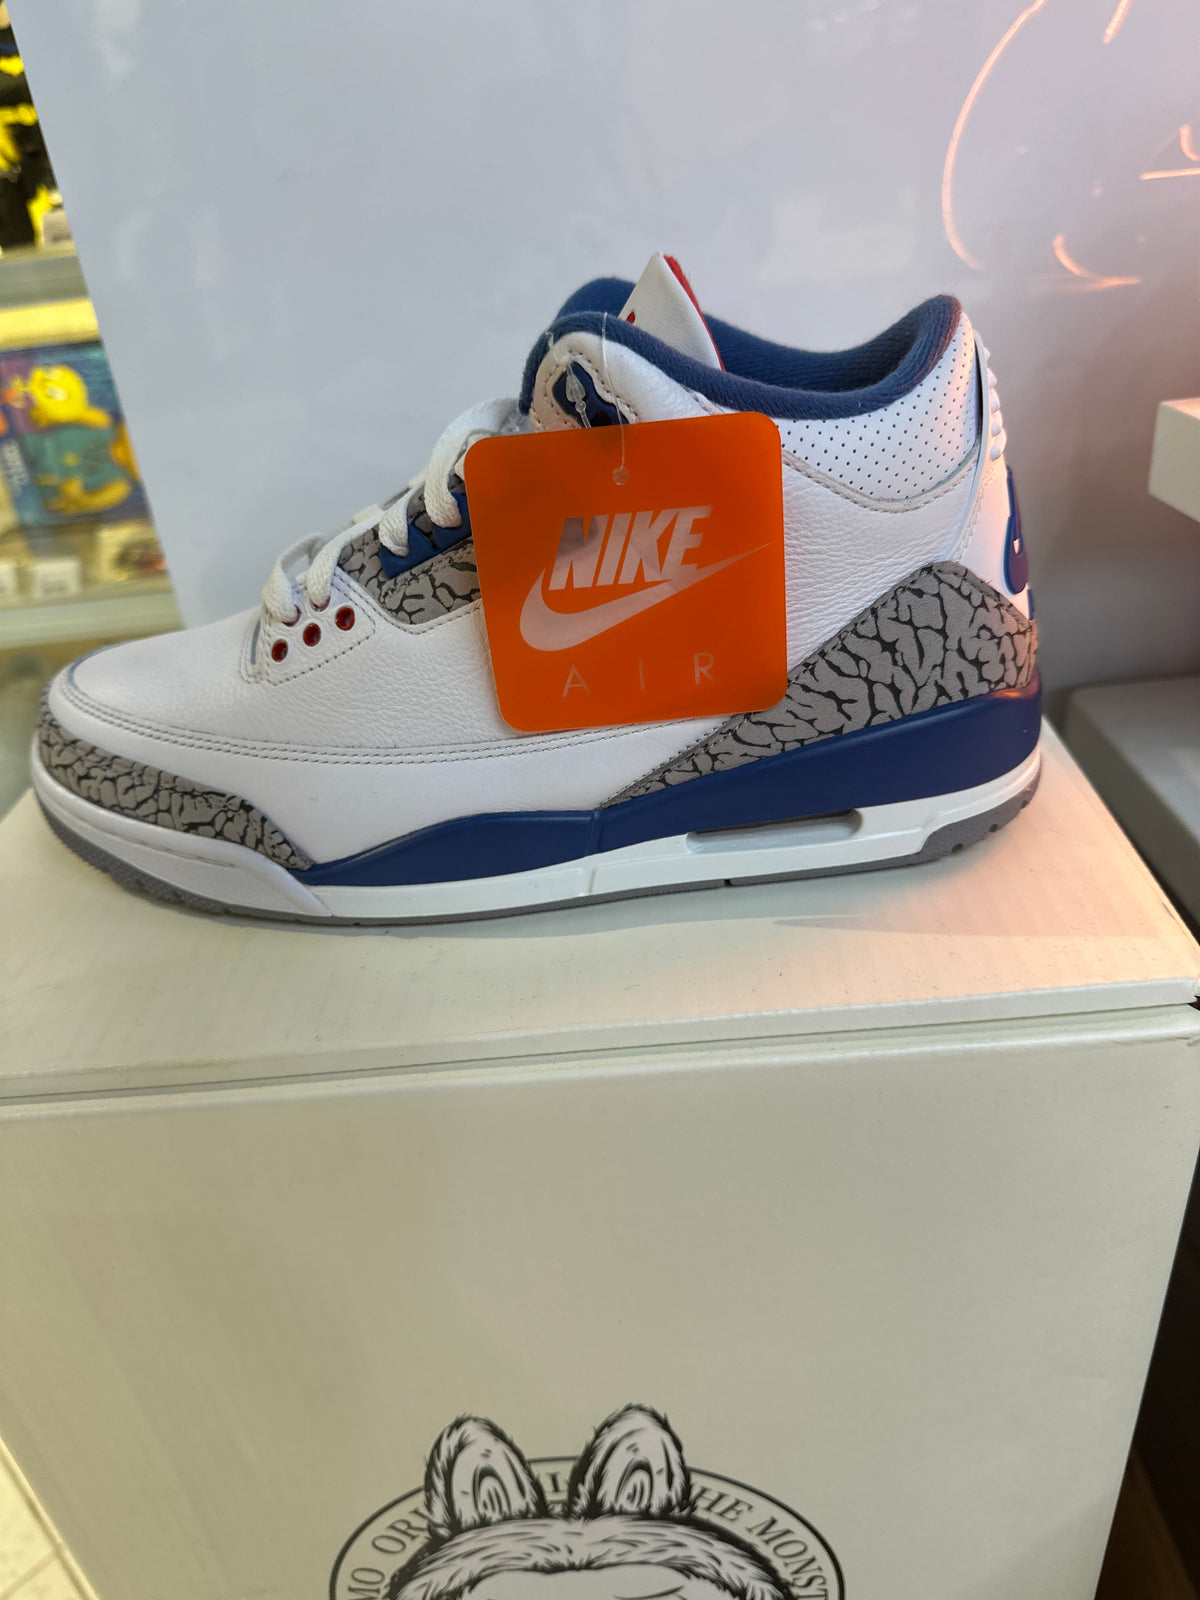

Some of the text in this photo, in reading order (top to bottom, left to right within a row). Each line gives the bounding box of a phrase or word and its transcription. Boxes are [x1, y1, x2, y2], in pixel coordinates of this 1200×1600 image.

[548, 504, 712, 591] NIKE
[562, 651, 716, 698] AIR
[692, 1486, 754, 1523] HE
